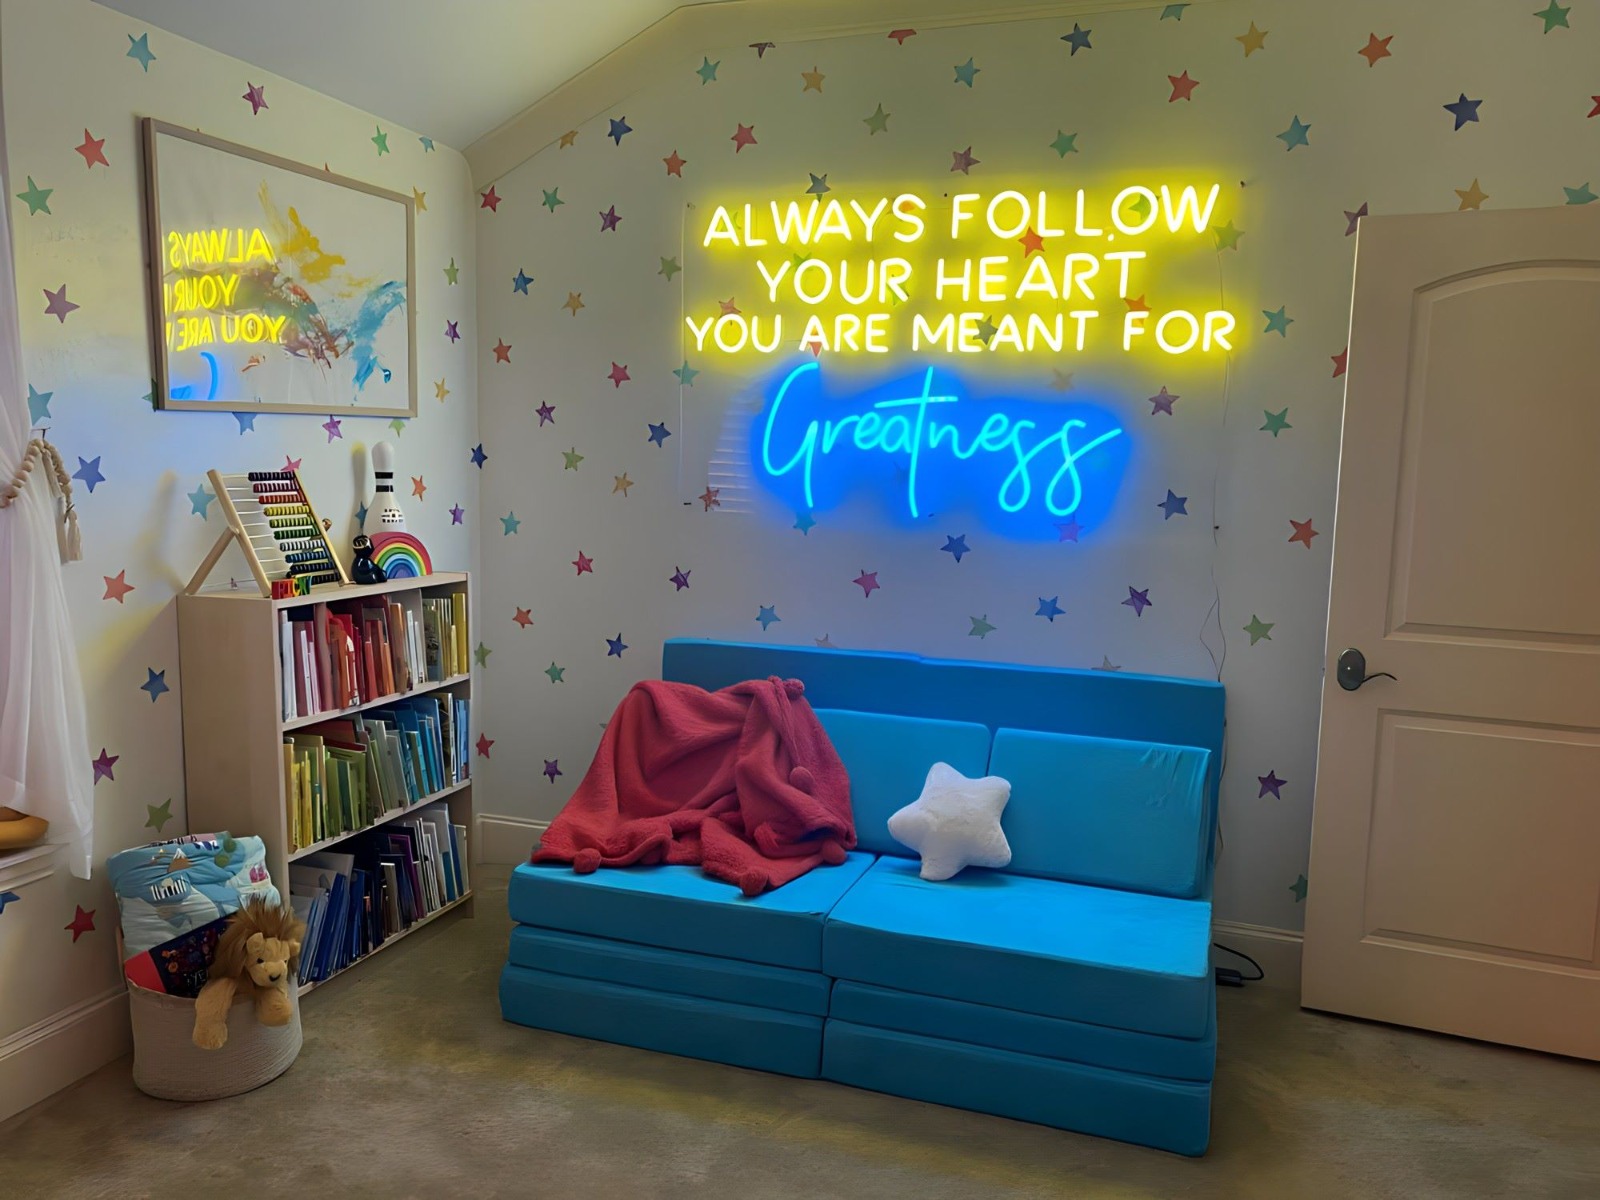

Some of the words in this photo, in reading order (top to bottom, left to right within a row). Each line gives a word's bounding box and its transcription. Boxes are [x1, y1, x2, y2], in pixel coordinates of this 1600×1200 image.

[703, 193, 926, 247] ALWAYS
[950, 183, 1220, 242] FOLLOW
[756, 257, 912, 305] YOUR
[936, 251, 1146, 301] HEART
[685, 314, 782, 353] YOU
[798, 313, 890, 352] ARE
[912, 310, 1099, 352] MEANT
[1123, 310, 1236, 354] FOR
[762, 361, 1122, 518] Greatness
